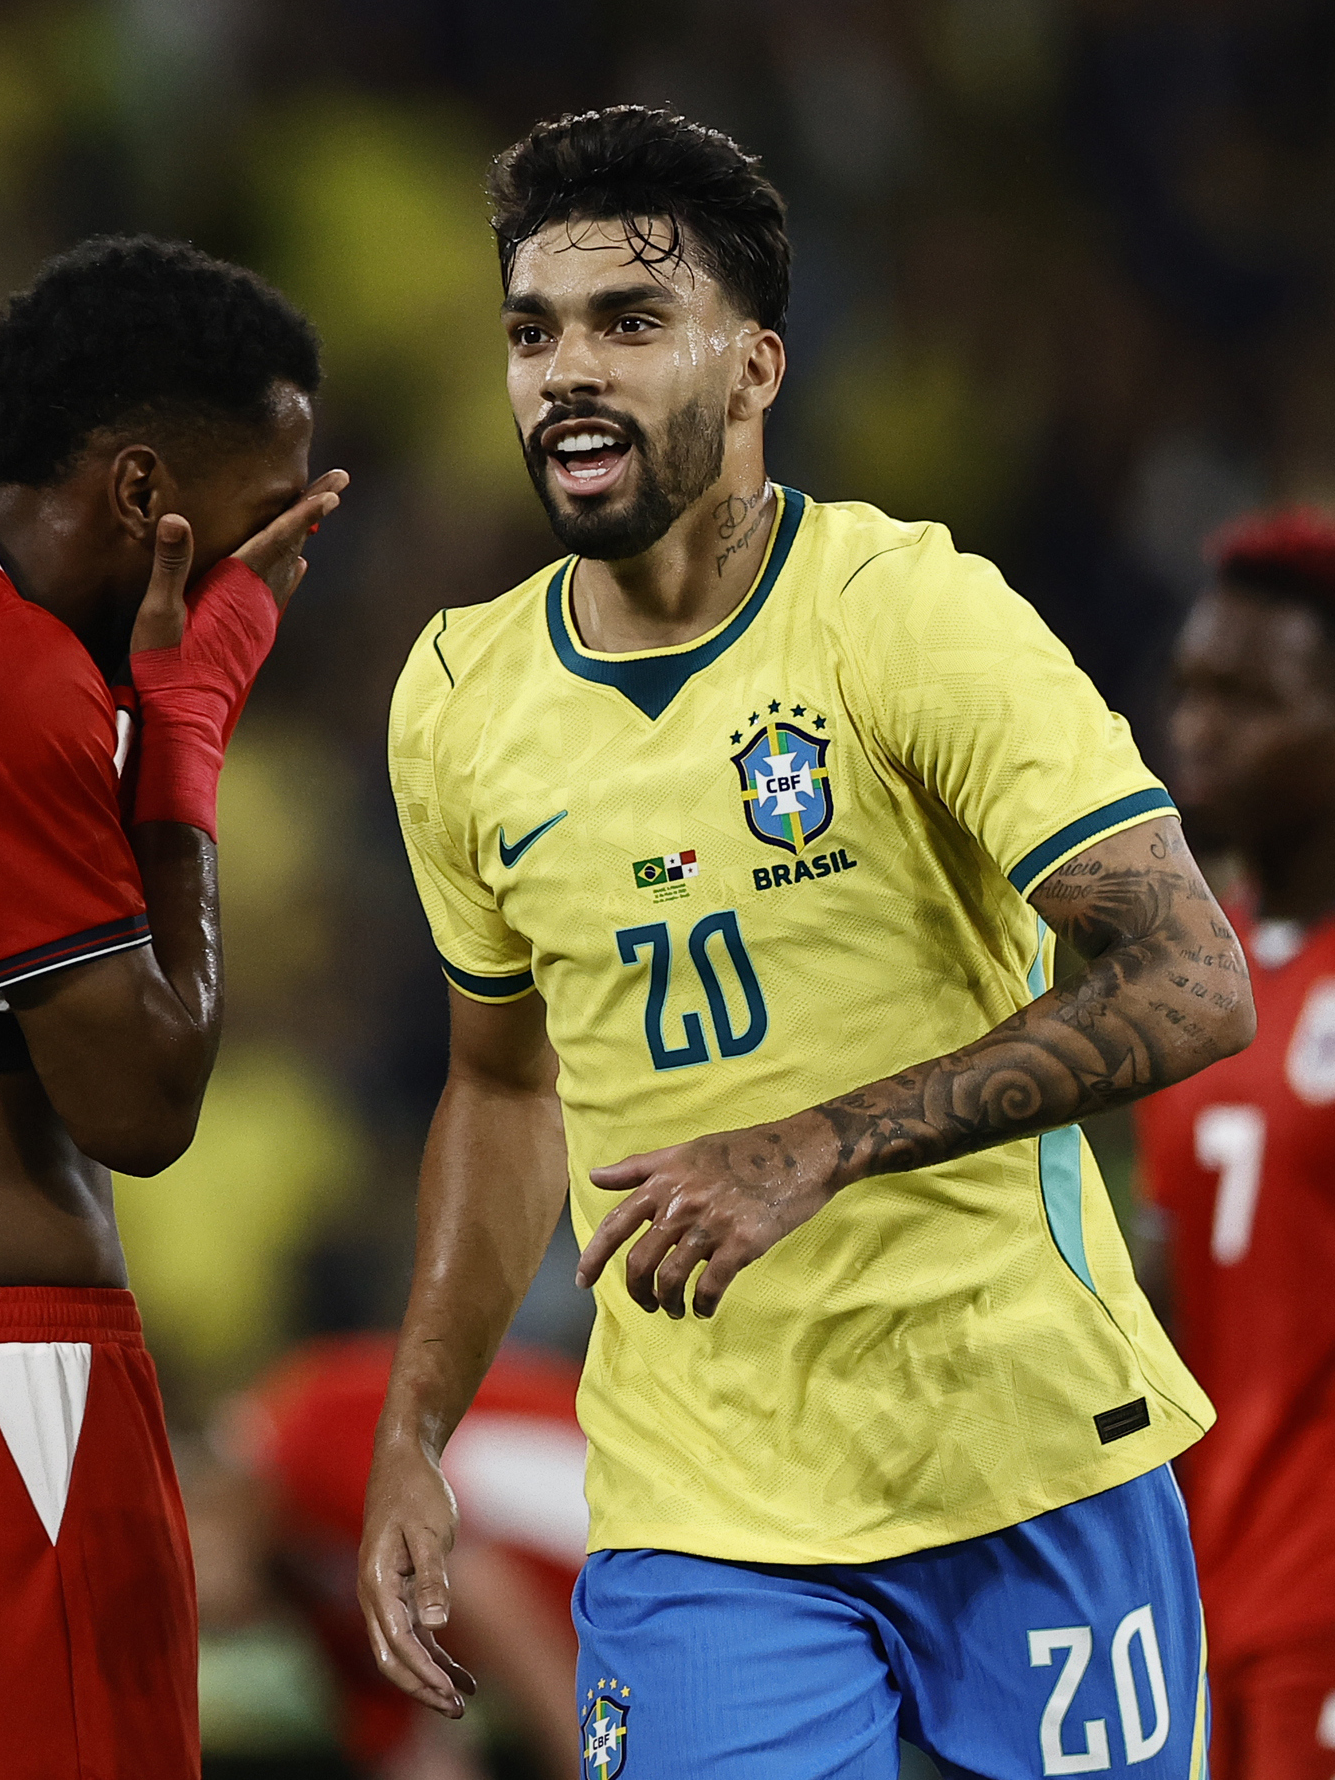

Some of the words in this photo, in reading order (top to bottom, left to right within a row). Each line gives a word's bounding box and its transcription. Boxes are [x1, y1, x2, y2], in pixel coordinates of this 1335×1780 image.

[766, 774, 801, 794] CBF
[752, 848, 858, 891] BRASIL
[615, 908, 769, 1071] 20
[1026, 1602, 1171, 1777] 20
[592, 1733, 610, 1751] CBF
